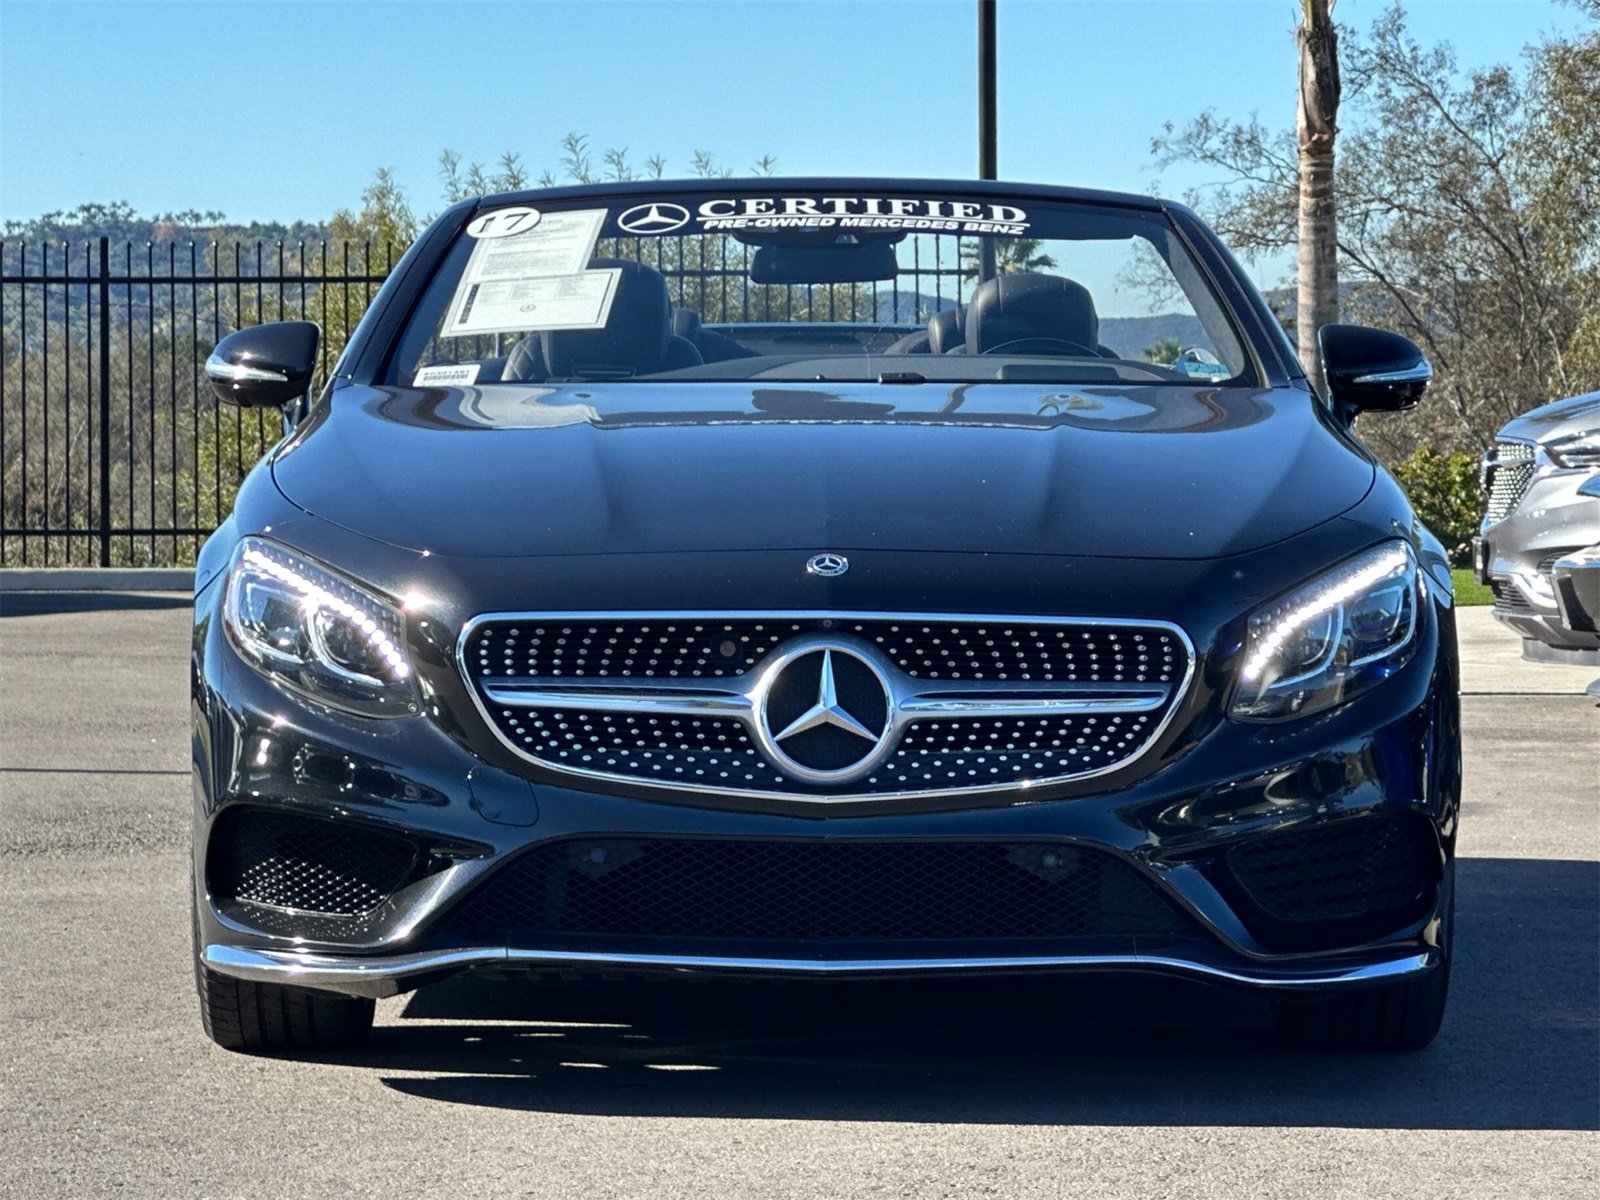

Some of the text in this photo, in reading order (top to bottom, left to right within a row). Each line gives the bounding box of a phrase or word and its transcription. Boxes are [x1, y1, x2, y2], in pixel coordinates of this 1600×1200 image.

[698, 197, 1027, 222] CERTIFIED
[476, 212, 532, 234] 17
[703, 217, 1026, 235] PRE-OWNED MERCEDES BENZ
